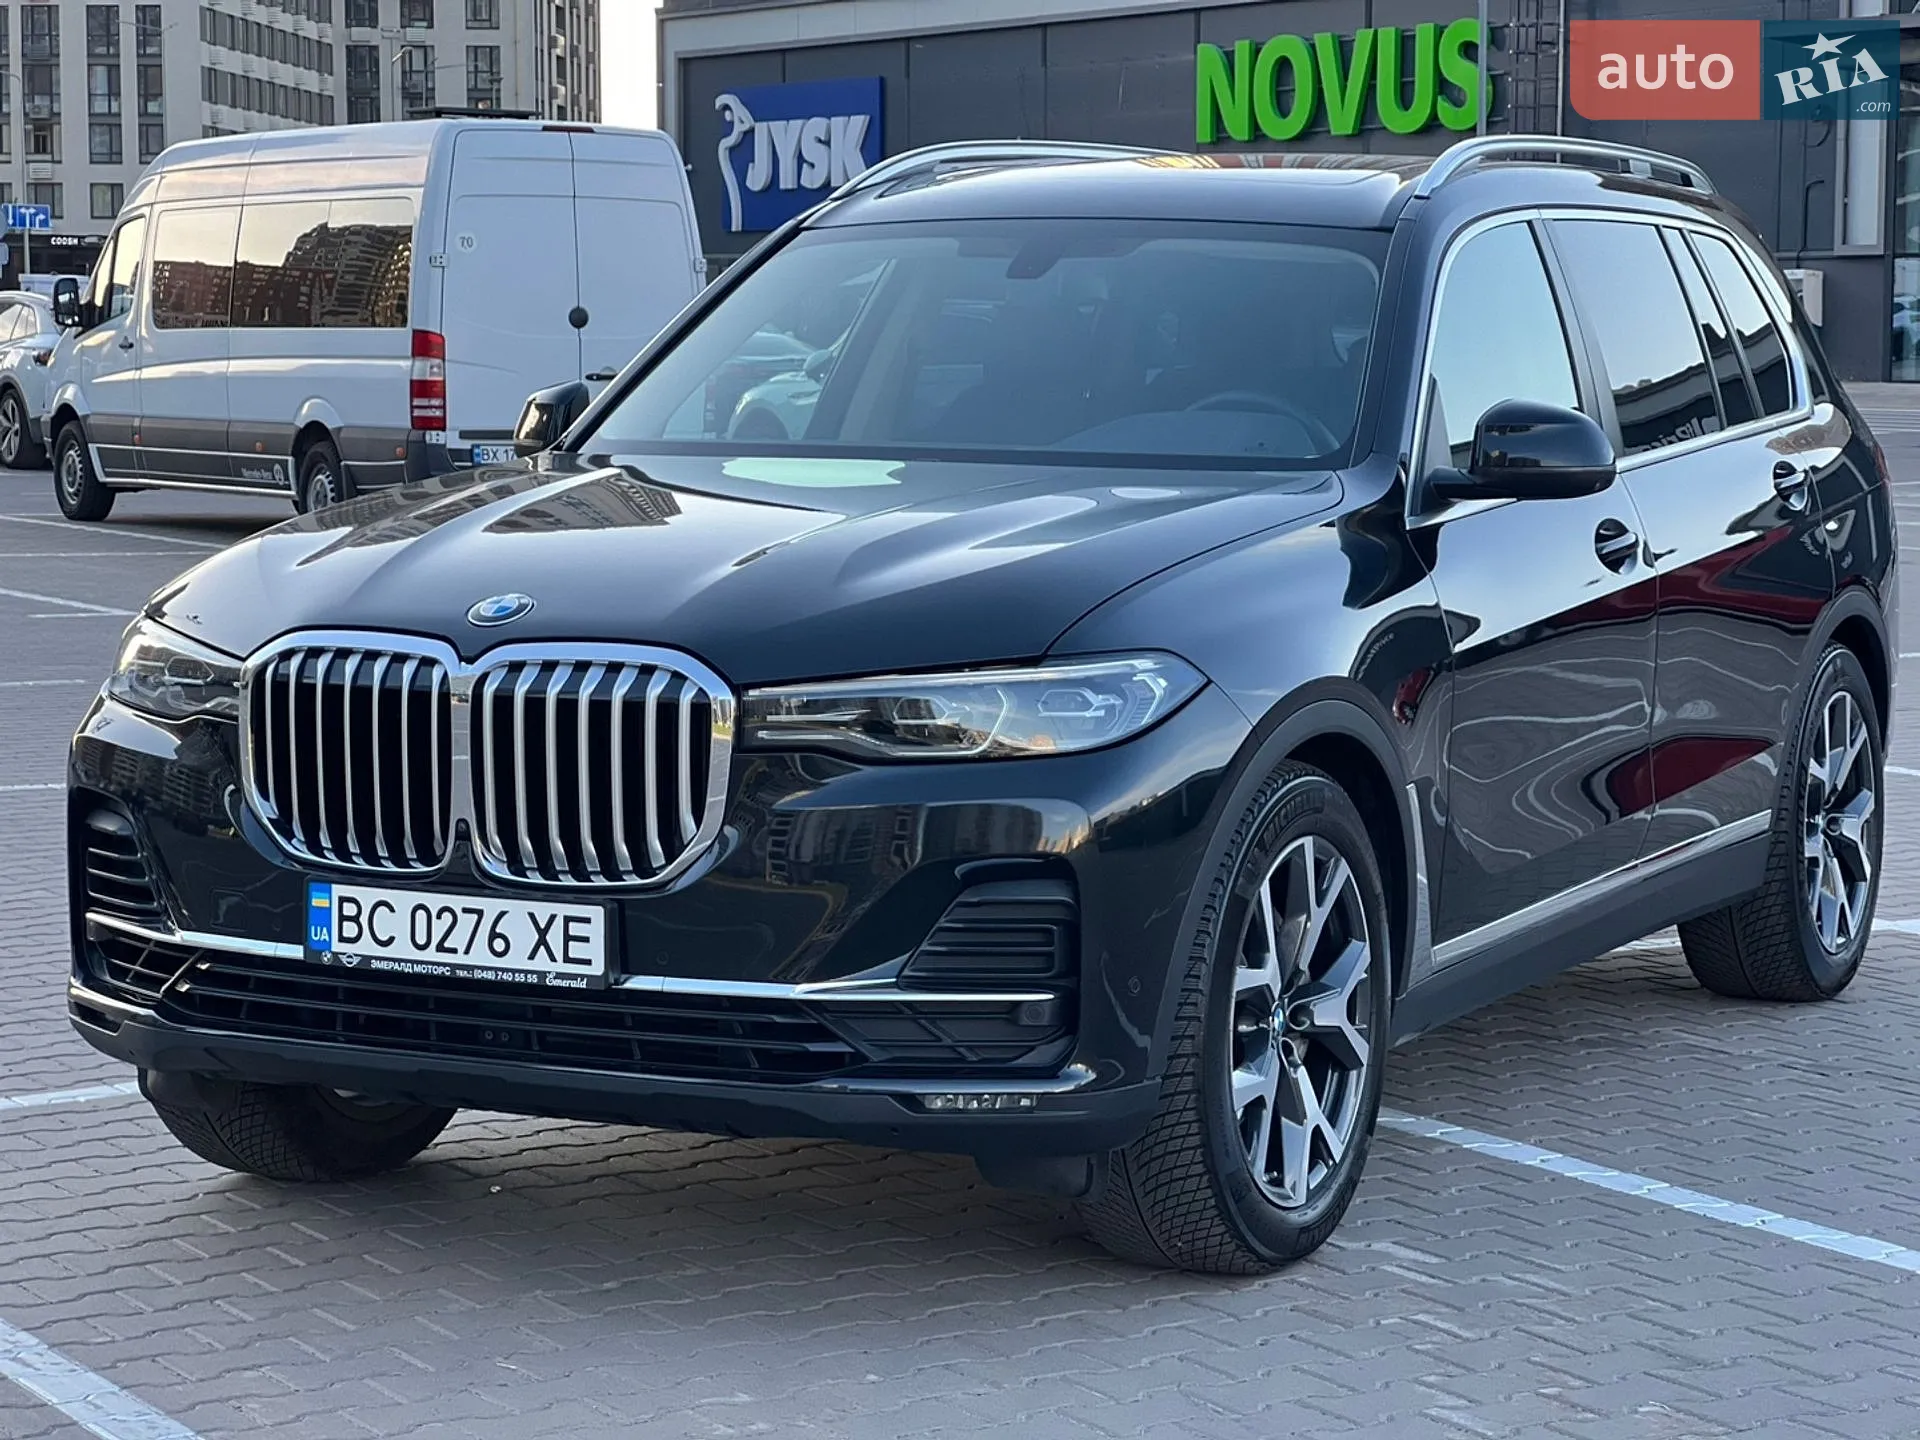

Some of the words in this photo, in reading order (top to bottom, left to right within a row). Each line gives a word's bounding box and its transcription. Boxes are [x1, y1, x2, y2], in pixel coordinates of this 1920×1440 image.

[1196, 17, 1493, 143] NOVUS
[746, 115, 870, 192] JYSK
[459, 235, 474, 249] 70
[481, 448, 499, 461] BX
[311, 925, 330, 942] UA
[338, 895, 396, 948] BC
[410, 902, 511, 959] 0276
[526, 911, 593, 966] XE
[370, 959, 412, 974] ЭМЕРАЛД
[413, 964, 451, 976] МОТОРС
[497, 971, 513, 981] 740
[514, 972, 526, 982] 55
[527, 974, 538, 984] 55
[545, 971, 587, 989] Emerald
